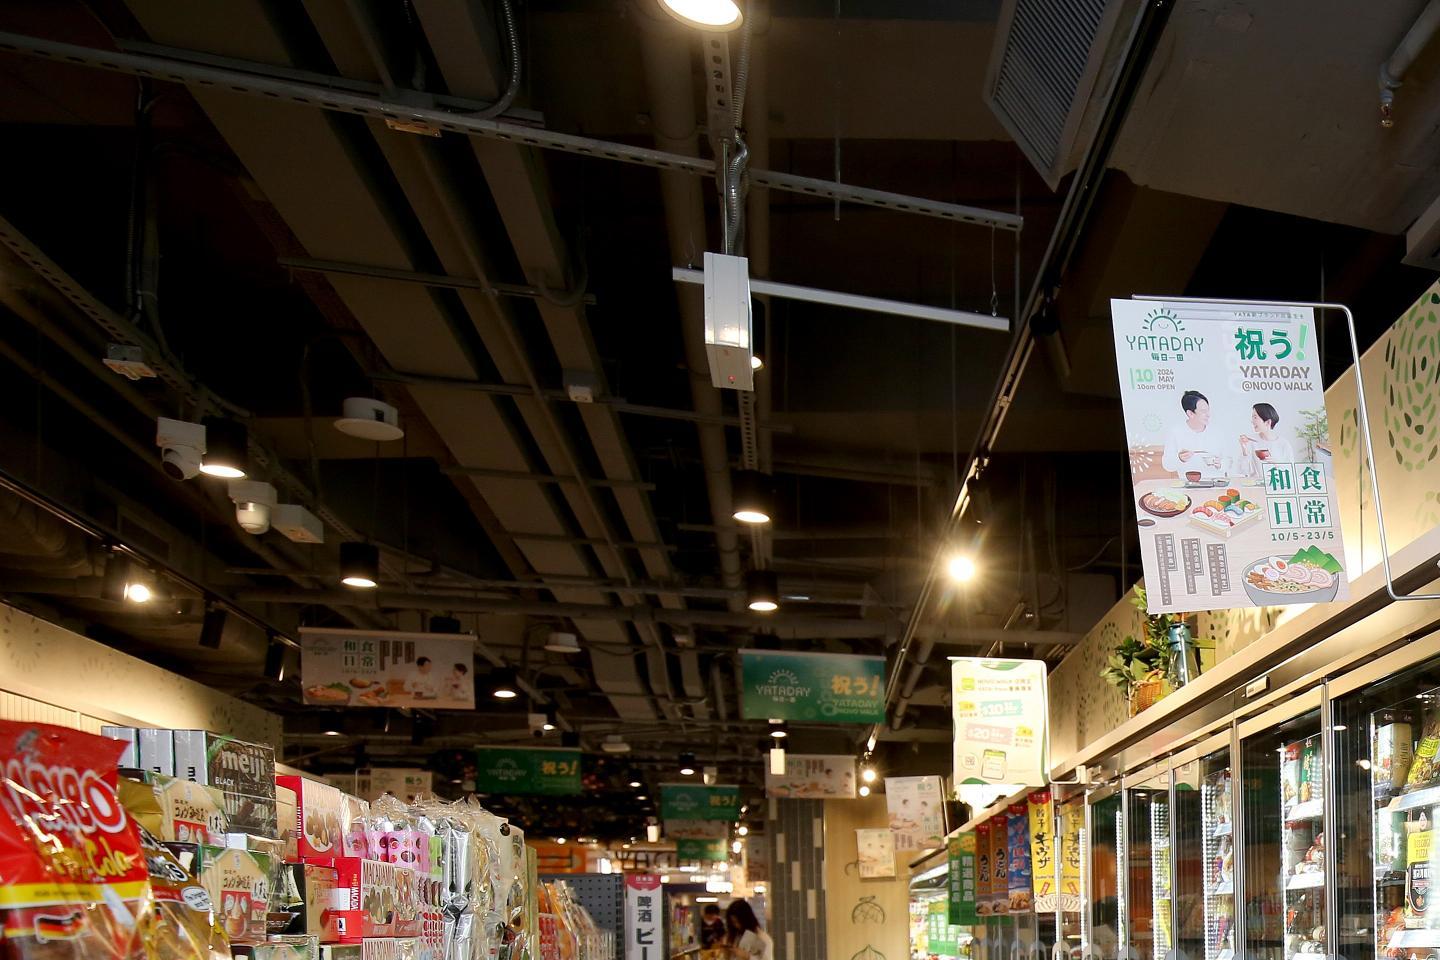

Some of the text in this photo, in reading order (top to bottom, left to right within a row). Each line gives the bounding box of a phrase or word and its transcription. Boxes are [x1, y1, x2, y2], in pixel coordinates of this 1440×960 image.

[1126, 335, 1204, 352] YATADAY
[1136, 370, 1153, 382] 10
[1240, 366, 1310, 379] YATADAY
[1242, 381, 1313, 392] @NOVO WALK
[1267, 466, 1322, 491] 和食
[1274, 500, 1326, 525] 日常
[755, 685, 811, 697] YATADAY
[222, 746, 267, 783] meiji
[214, 776, 235, 787] BLACK
